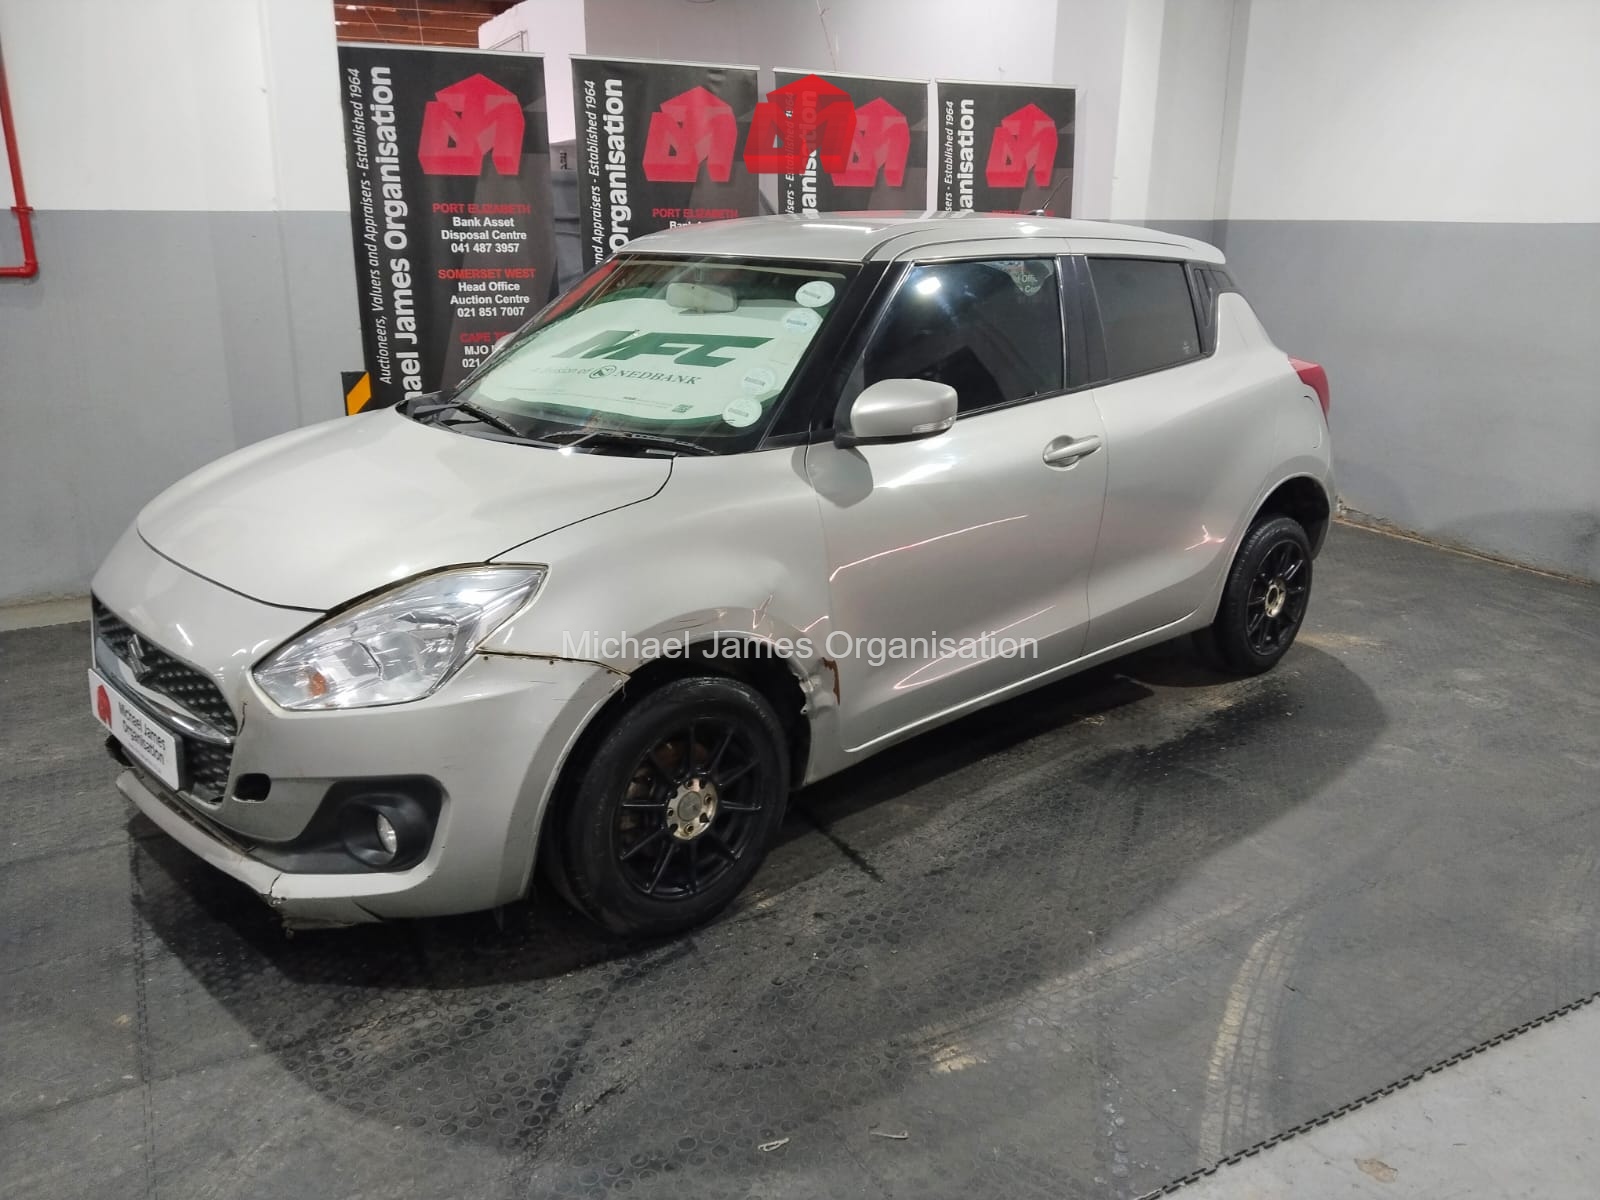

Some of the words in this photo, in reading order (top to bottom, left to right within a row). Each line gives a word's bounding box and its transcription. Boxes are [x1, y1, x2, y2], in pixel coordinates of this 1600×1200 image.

[347, 68, 362, 98] 1964
[584, 80, 596, 108] 1964
[946, 101, 954, 125] 1964
[350, 101, 369, 169] Established
[585, 111, 600, 176] Established
[370, 66, 408, 250] Organisation
[603, 79, 631, 253] Organisation
[944, 127, 953, 184] Established
[360, 180, 378, 242] Appraisers
[432, 203, 465, 213] PORT
[467, 203, 531, 214] ELIZABETH
[590, 186, 605, 244] Appraisers
[652, 208, 680, 218] PORT
[683, 208, 738, 218] ELIZABETH
[452, 216, 481, 227] Bank
[483, 217, 515, 227] Asset
[441, 229, 489, 241] Disposal
[492, 230, 527, 240] Centre
[364, 243, 379, 267] and
[451, 243, 470, 253] 041
[473, 243, 492, 253] 487
[495, 243, 520, 252] 3957
[592, 245, 604, 264] nd
[438, 269, 502, 279] SOMERSET
[504, 268, 536, 279] WEST
[369, 269, 384, 311] Valuers
[458, 282, 486, 292] Head
[488, 281, 520, 291] Office
[390, 258, 417, 344] James
[450, 295, 492, 304] Auction
[494, 294, 530, 304] Centre
[457, 308, 475, 317] 021
[479, 307, 497, 317] 851
[500, 307, 525, 316] 7007
[460, 332, 490, 343] CAPE
[375, 316, 392, 384] Auctioneers,
[464, 345, 489, 355] MJO
[462, 358, 480, 367] 021
[614, 370, 701, 384] NEDBANK
